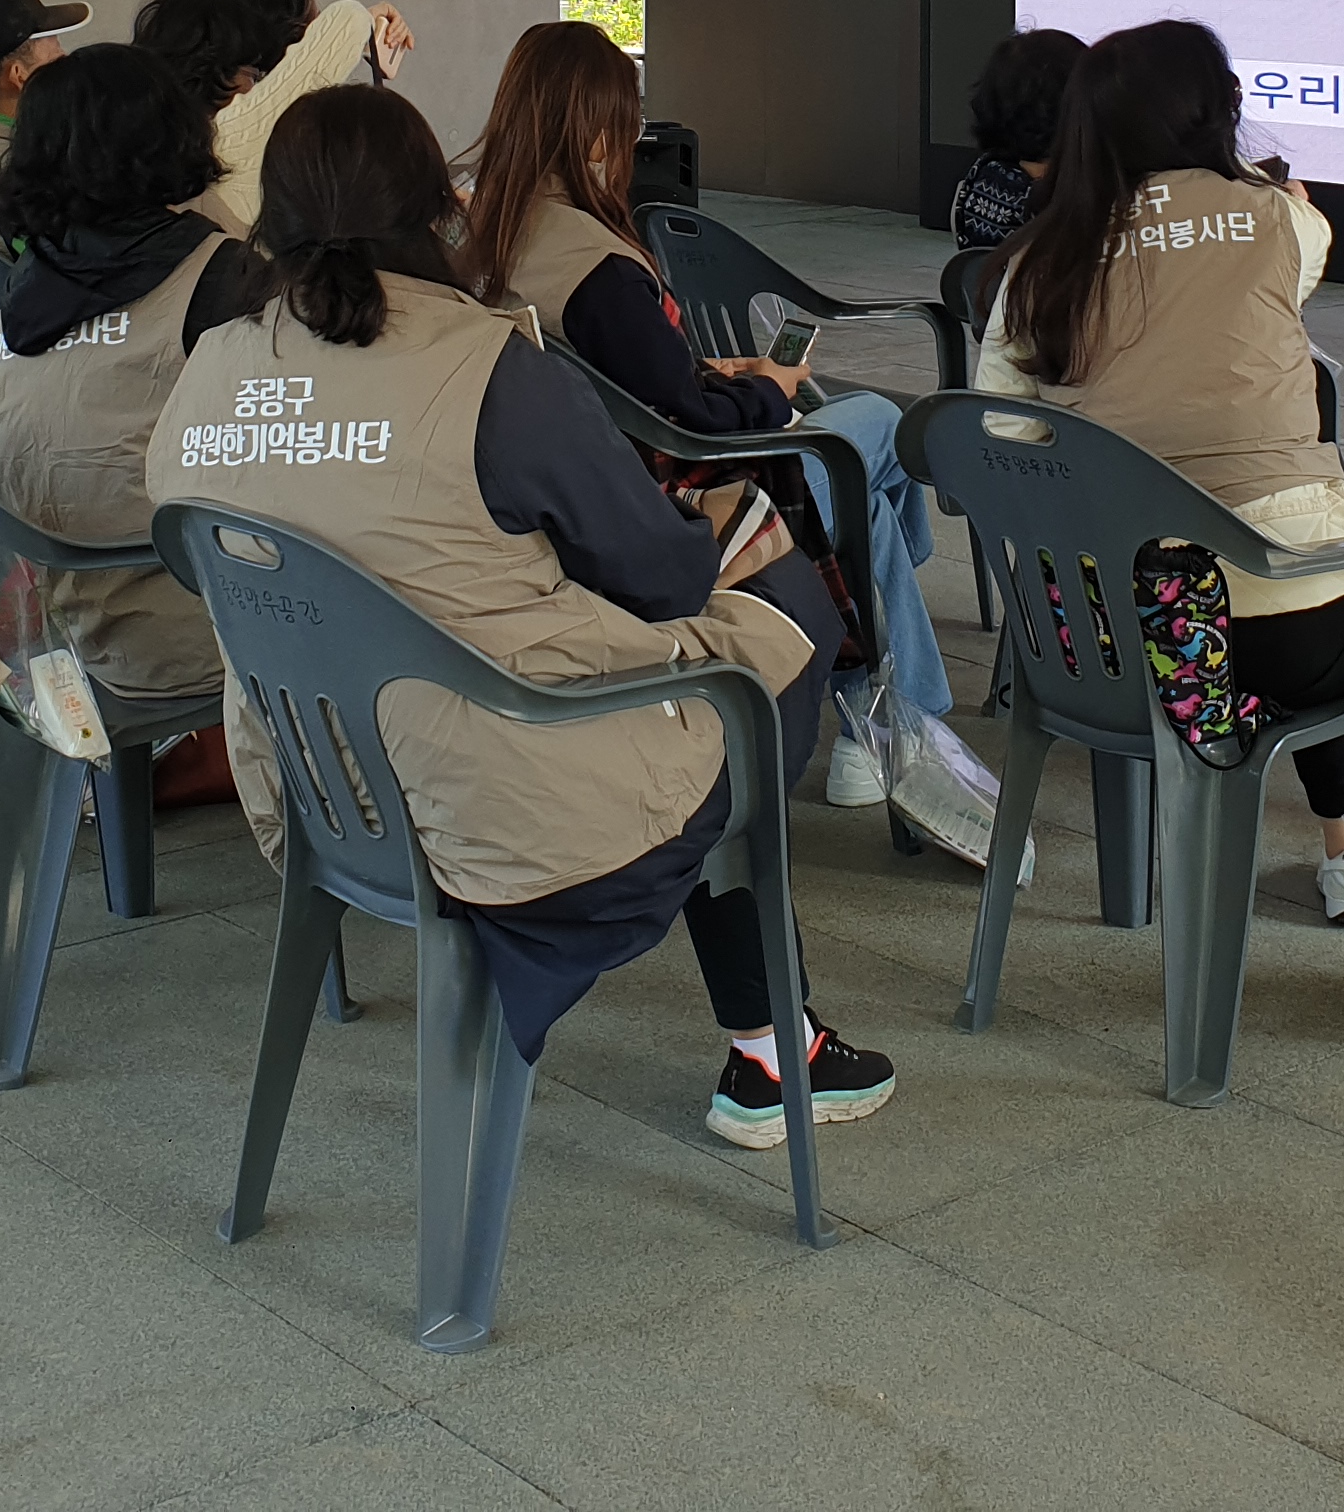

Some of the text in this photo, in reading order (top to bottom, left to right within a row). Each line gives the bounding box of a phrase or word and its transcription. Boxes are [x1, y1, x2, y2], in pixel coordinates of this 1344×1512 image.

[1249, 71, 1341, 115] 우리
[234, 376, 315, 418] 중랑구
[181, 420, 392, 467] 영원한기억봉사단
